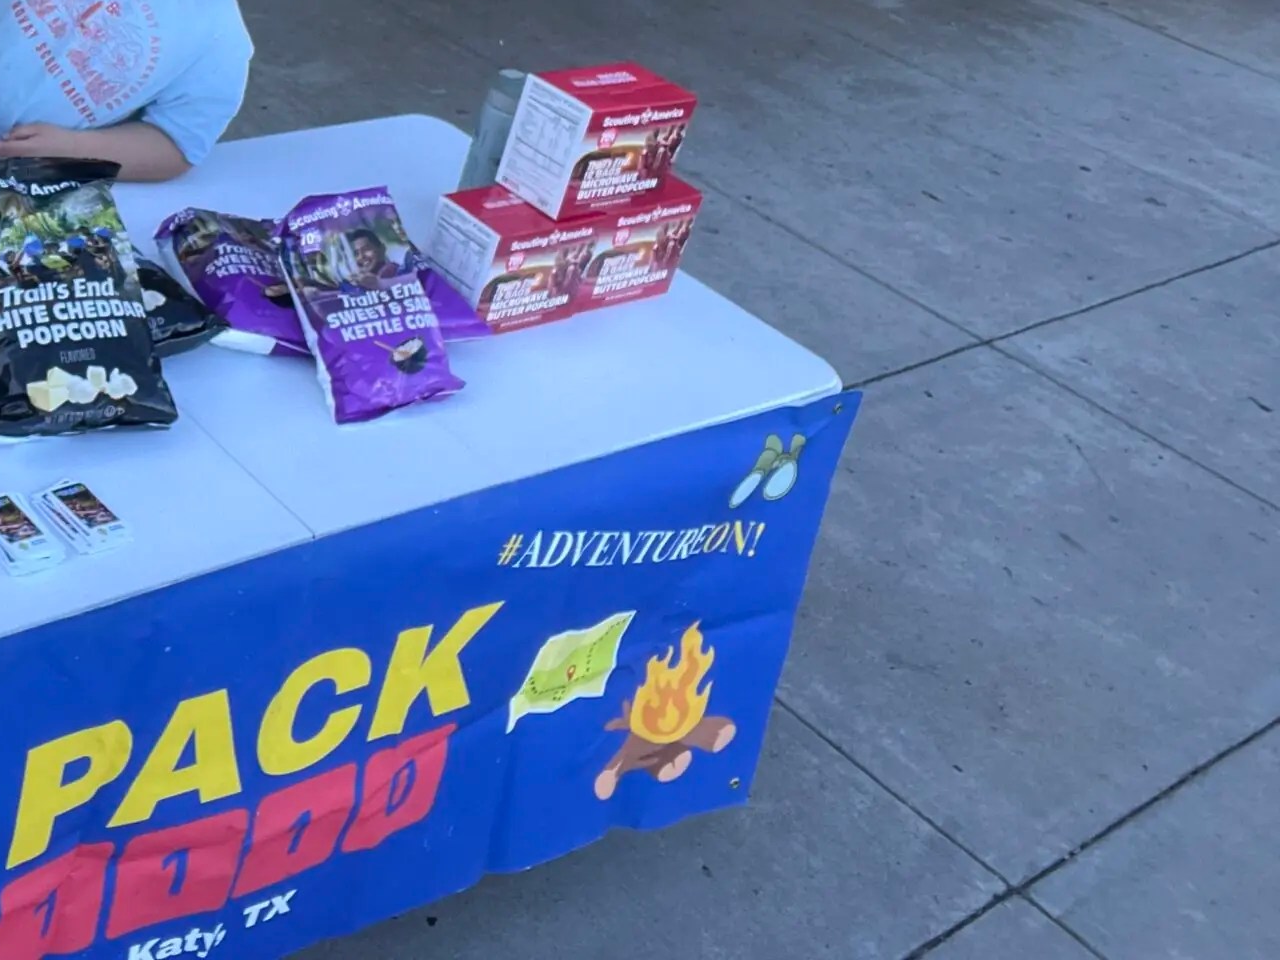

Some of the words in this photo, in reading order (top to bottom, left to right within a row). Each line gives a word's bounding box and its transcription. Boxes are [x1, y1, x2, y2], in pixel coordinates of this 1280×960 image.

[603, 115, 640, 128] Scouting
[651, 109, 684, 122] America
[577, 187, 615, 200] BUTTER
[615, 178, 658, 194] POPCORN
[581, 172, 639, 189] MICROWAVE
[288, 206, 339, 231] Scouting
[618, 213, 651, 227] Scouting
[511, 237, 548, 251] Scouting
[73, 277, 114, 298] End
[338, 289, 390, 308] Trail's
[391, 280, 424, 298] End
[593, 281, 629, 295] BUTTER
[628, 269, 668, 284] POPCORN
[52, 300, 146, 320] CHEDDAR
[486, 305, 525, 321] BUTTER
[525, 294, 568, 312] POPCORN
[489, 291, 548, 310] MICROWAVE
[326, 304, 387, 329] SWEET
[389, 301, 402, 316] &
[17, 319, 128, 349] POPCORN
[340, 317, 404, 342] KETTLE
[59, 347, 96, 364] FLAVORED
[496, 519, 766, 568] #ADVENTUREON!
[6, 600, 505, 870] PACK
[127, 922, 227, 960] Katy,
[242, 889, 298, 929] TX
